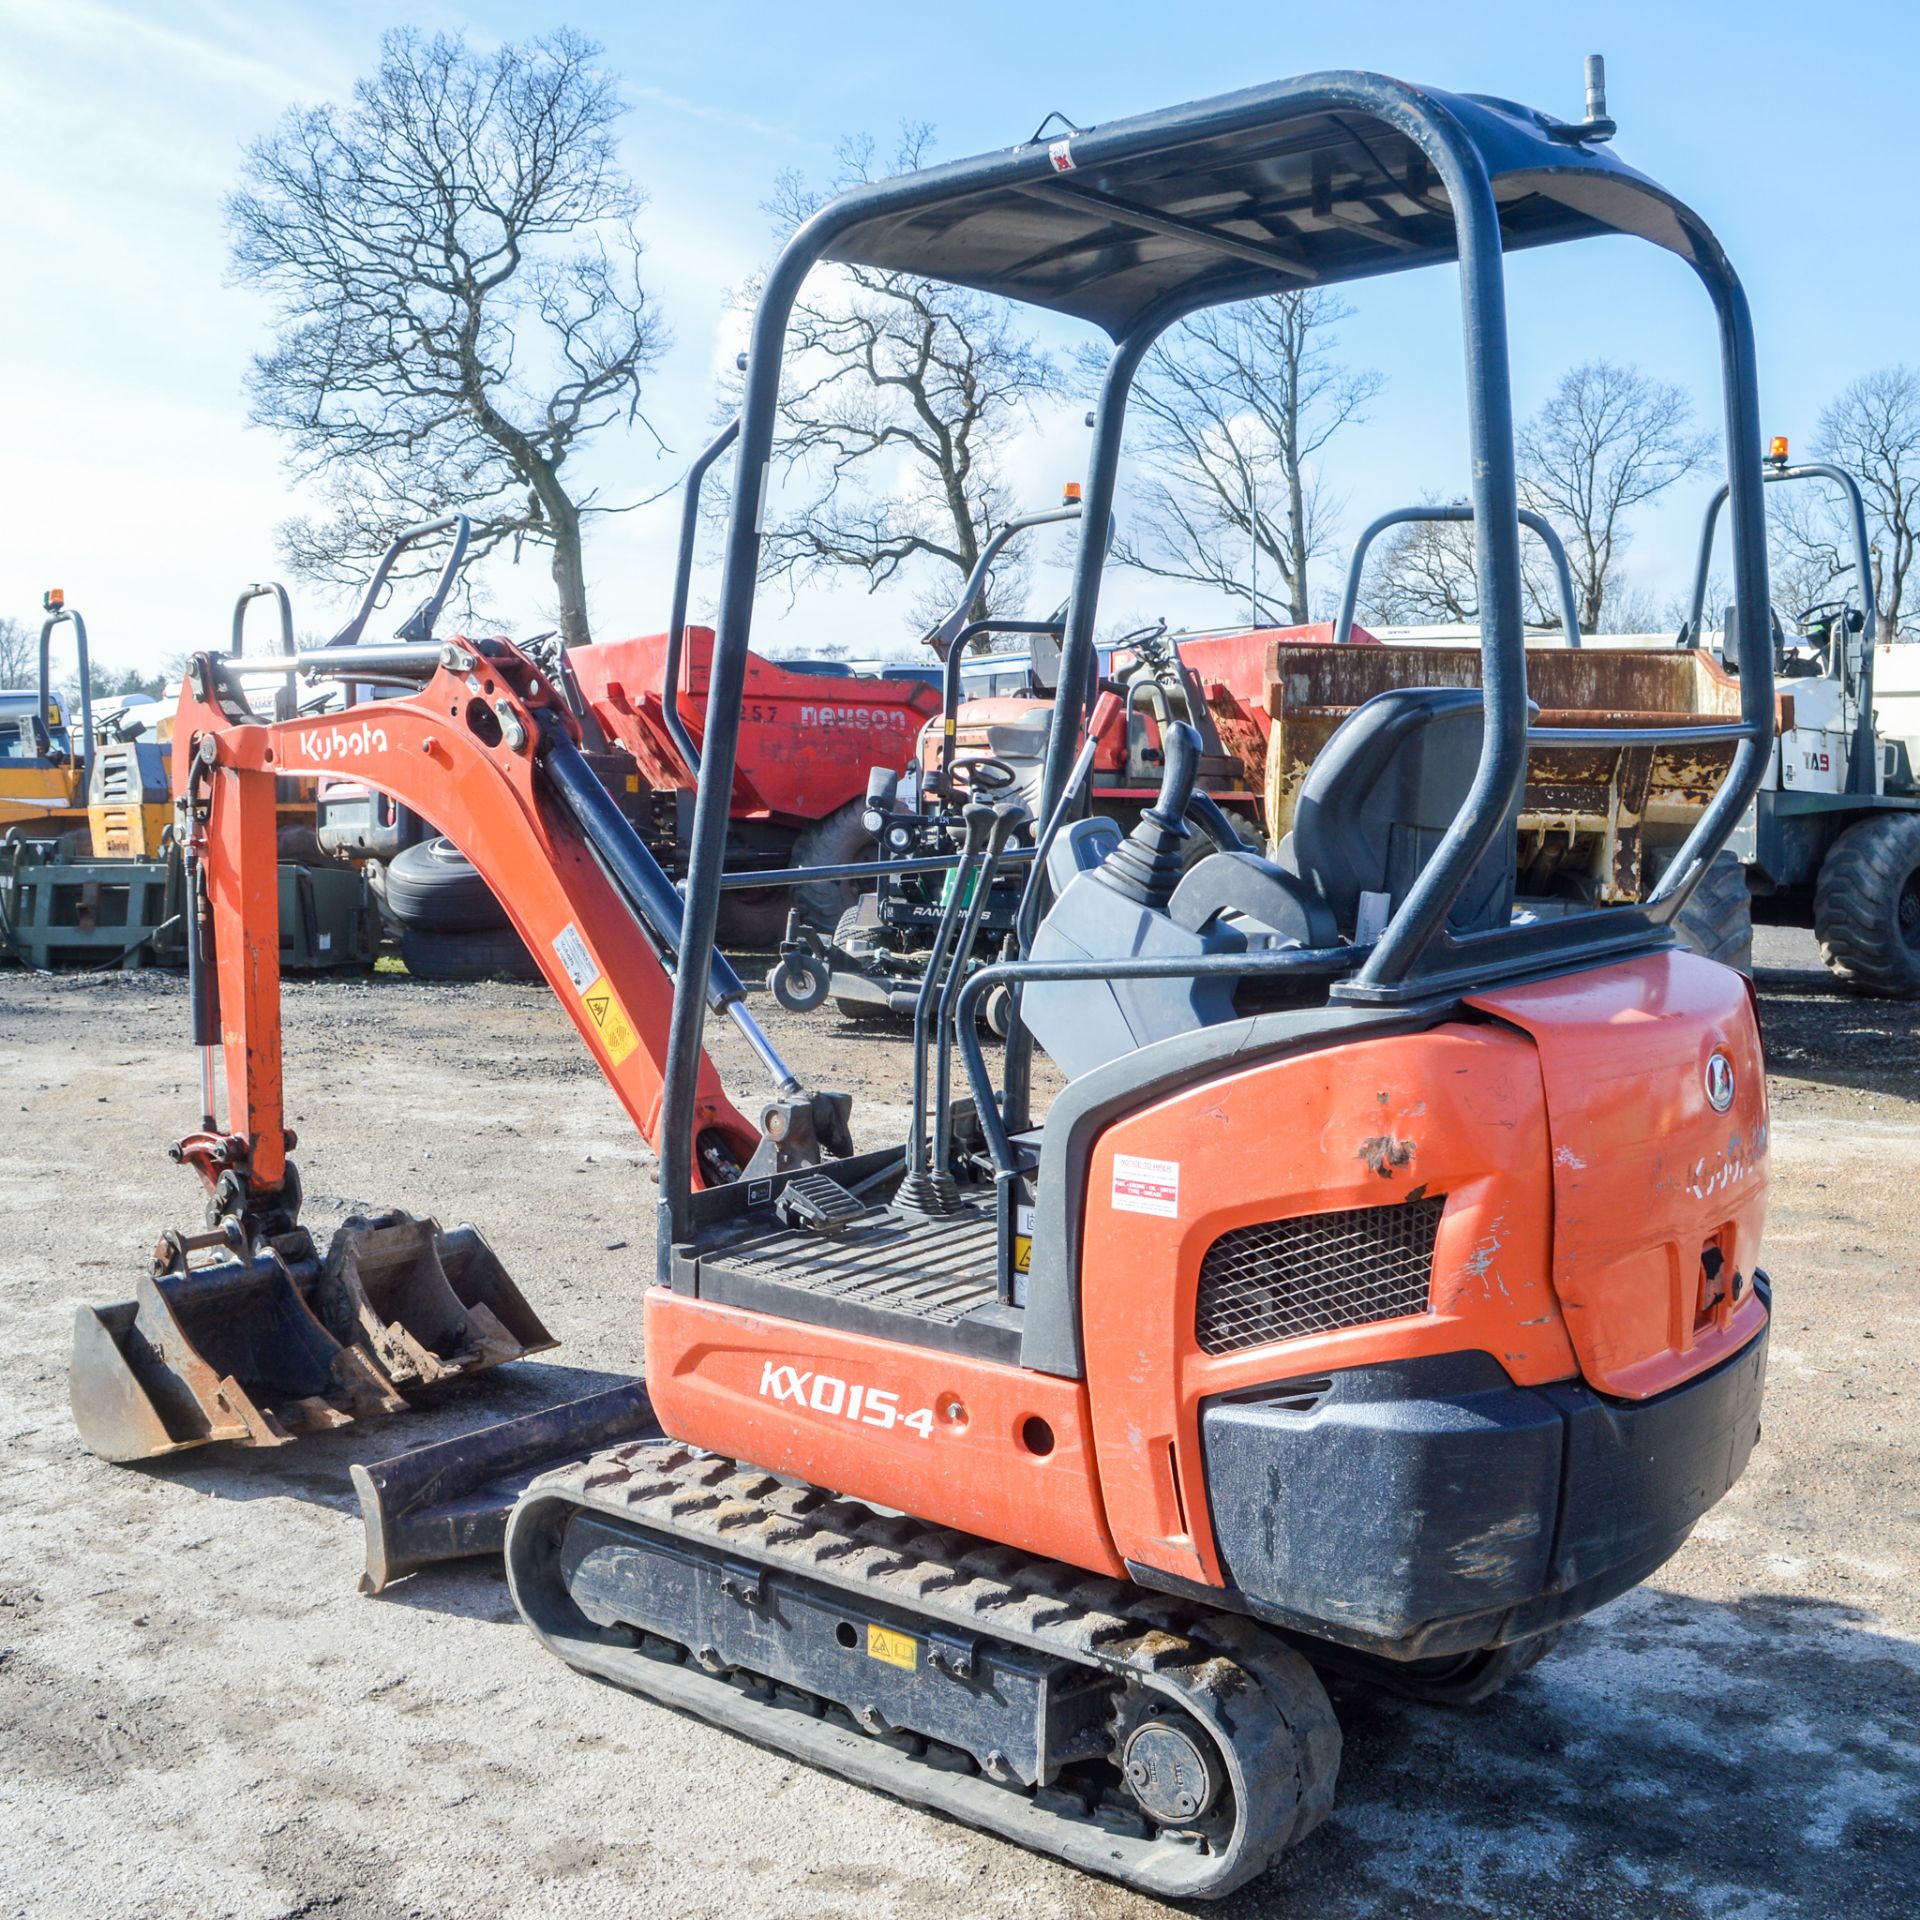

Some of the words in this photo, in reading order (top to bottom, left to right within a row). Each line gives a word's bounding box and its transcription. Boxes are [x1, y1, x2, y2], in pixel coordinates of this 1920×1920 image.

[801, 706, 906, 730] neuson
[300, 722, 388, 761] Kubota
[1802, 751, 1830, 772] TA9
[759, 1360, 935, 1439] KX015-4
